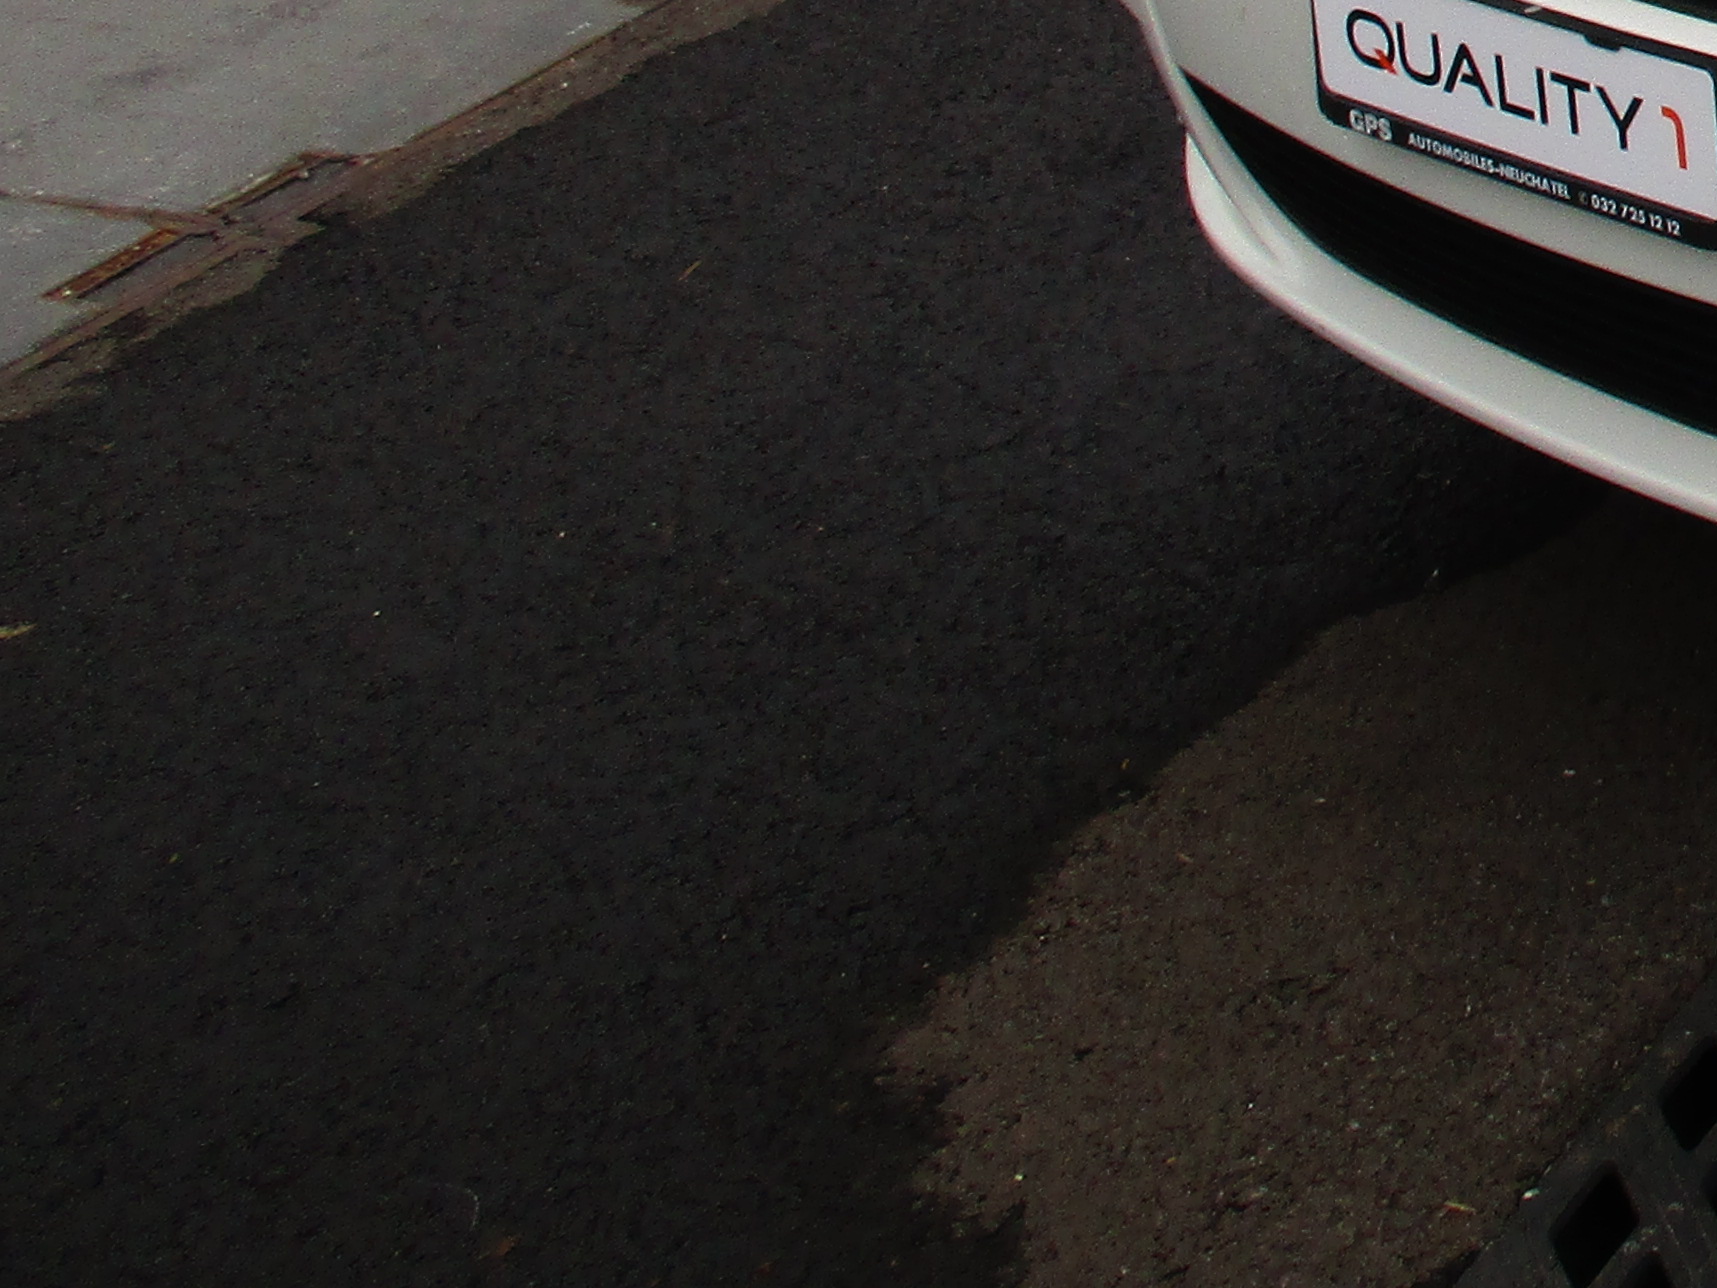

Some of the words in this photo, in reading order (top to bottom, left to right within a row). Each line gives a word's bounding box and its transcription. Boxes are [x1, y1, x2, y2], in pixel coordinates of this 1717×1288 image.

[1350, 109, 1392, 141] GPS
[1591, 194, 1617, 216] 032
[1620, 202, 1645, 225] 725
[1649, 210, 1663, 230] 12
[1667, 217, 1681, 237] 12
